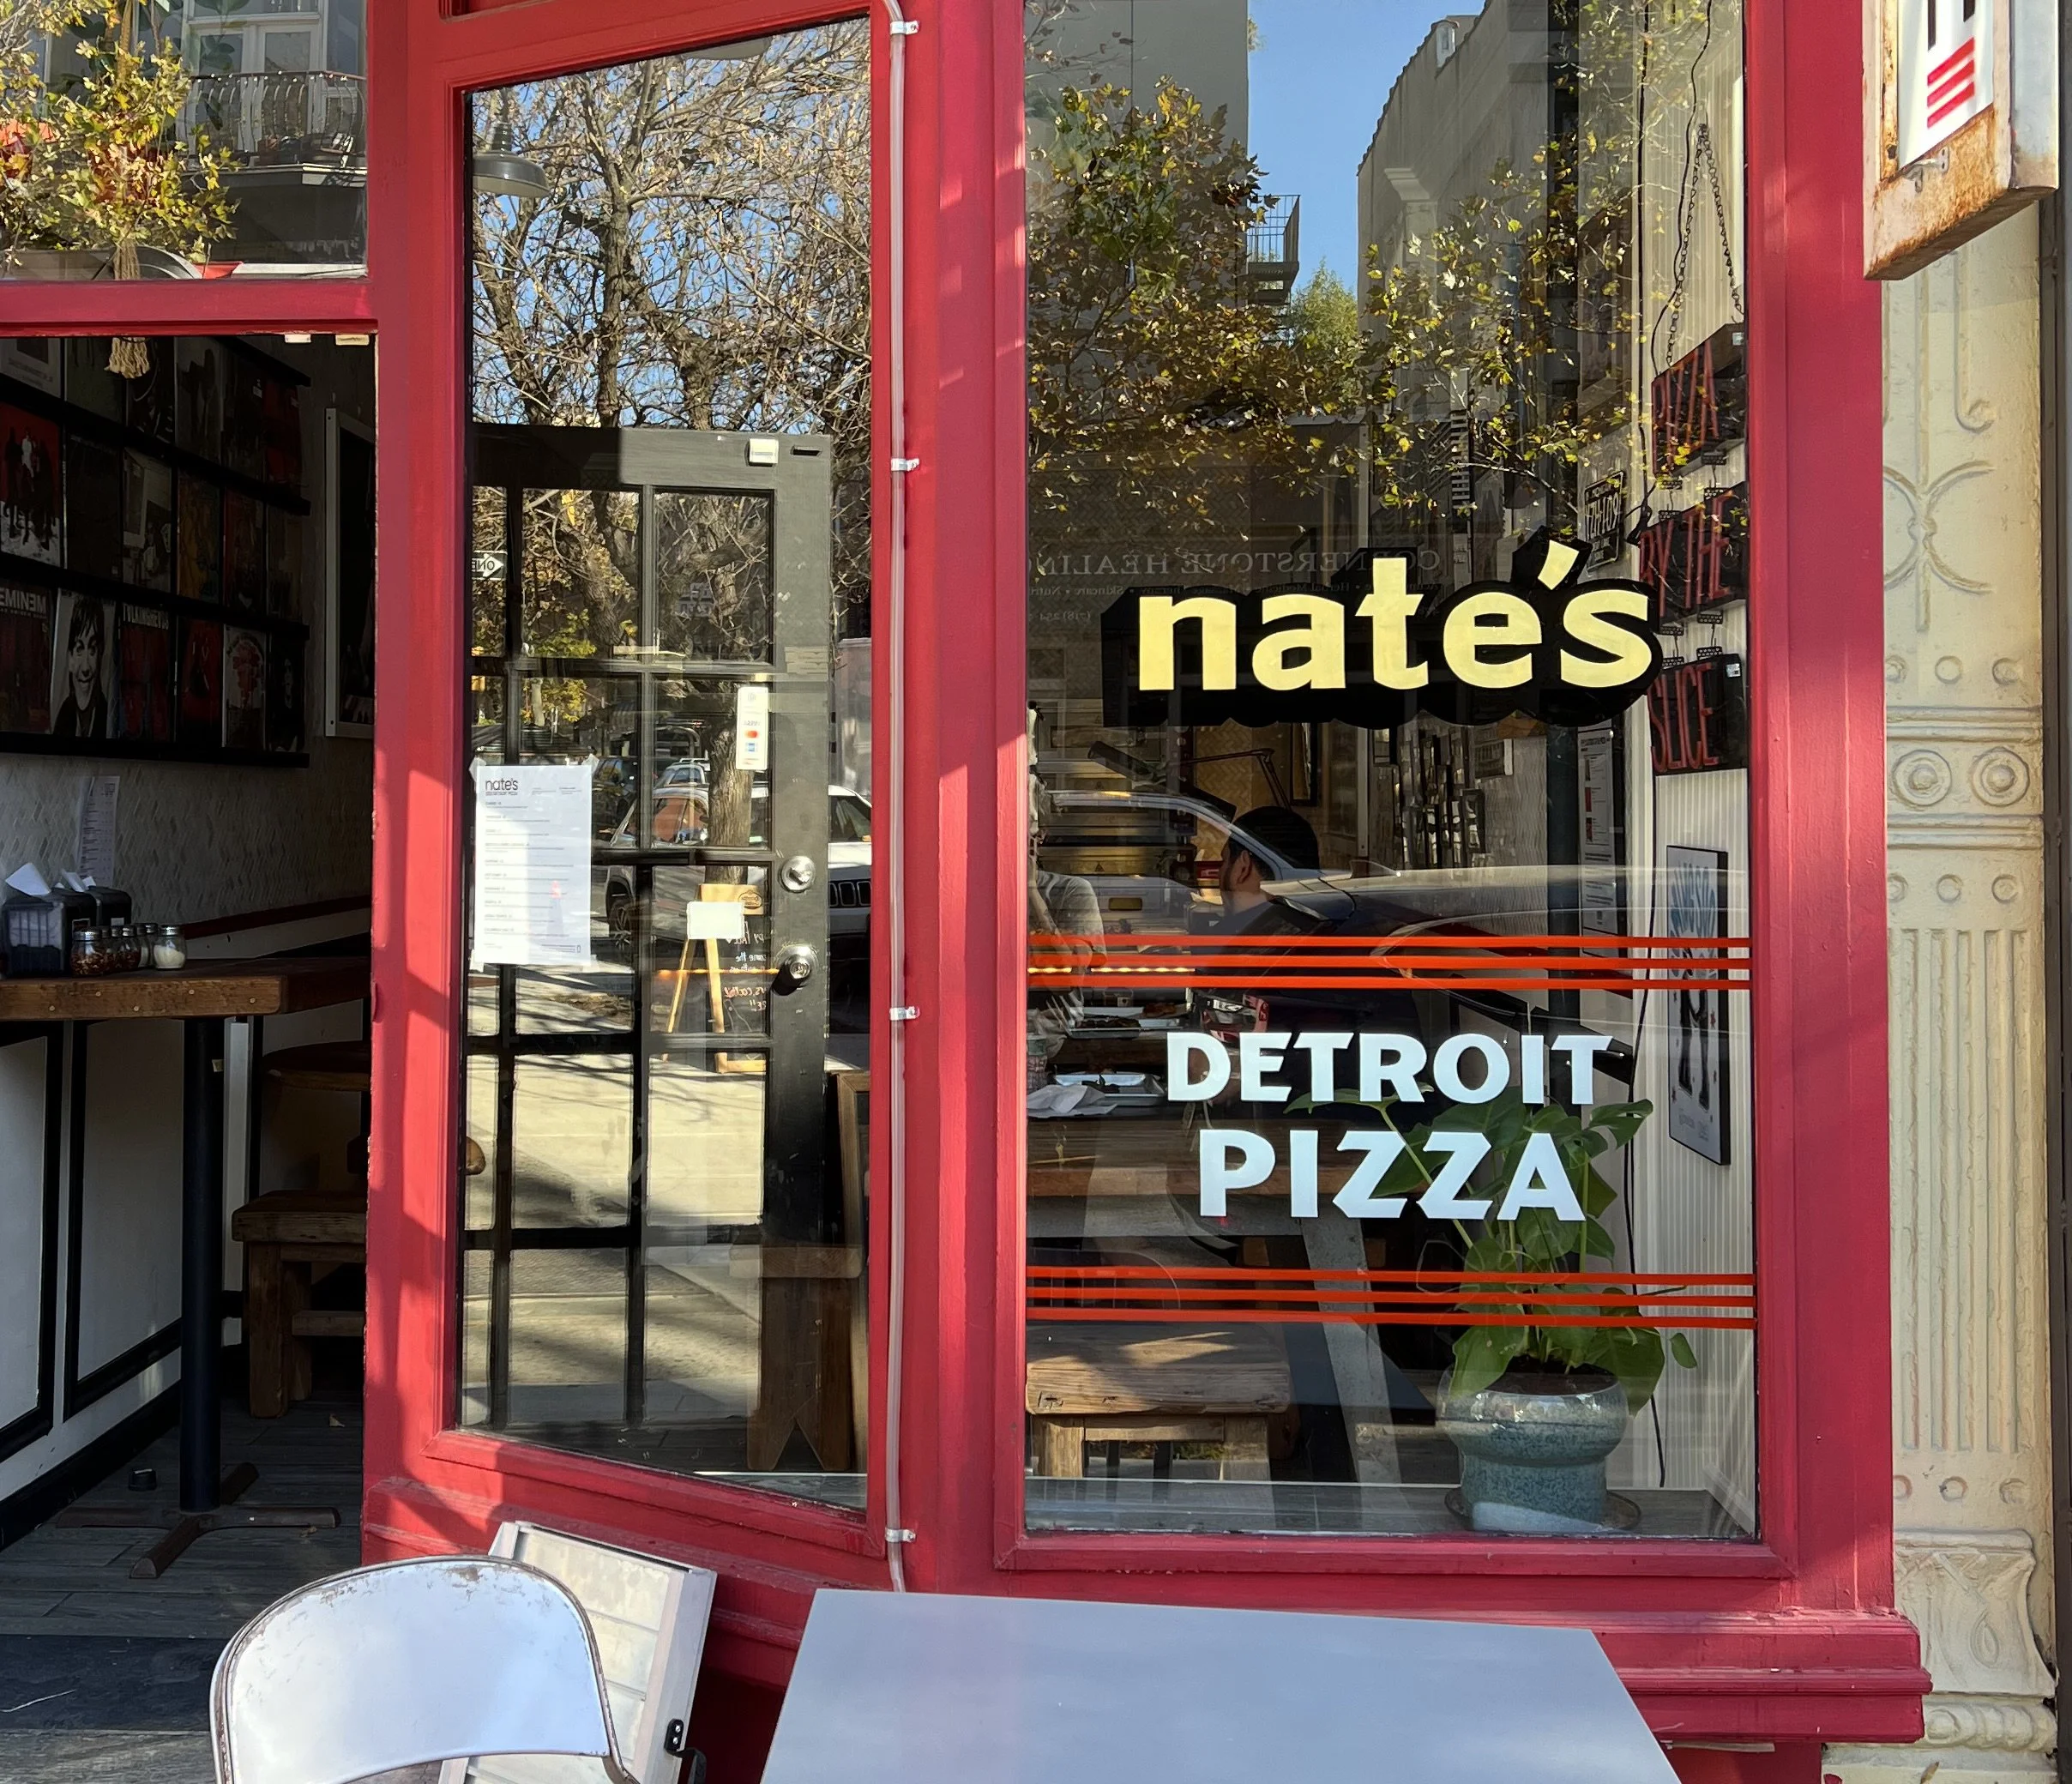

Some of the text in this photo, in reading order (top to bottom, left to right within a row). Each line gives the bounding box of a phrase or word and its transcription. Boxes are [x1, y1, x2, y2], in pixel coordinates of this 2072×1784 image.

[1140, 540, 1652, 690] nate's
[485, 777, 519, 791] nate's
[1166, 1032, 1613, 1105] DETROIT
[1199, 1129, 1586, 1221] PIZZA
